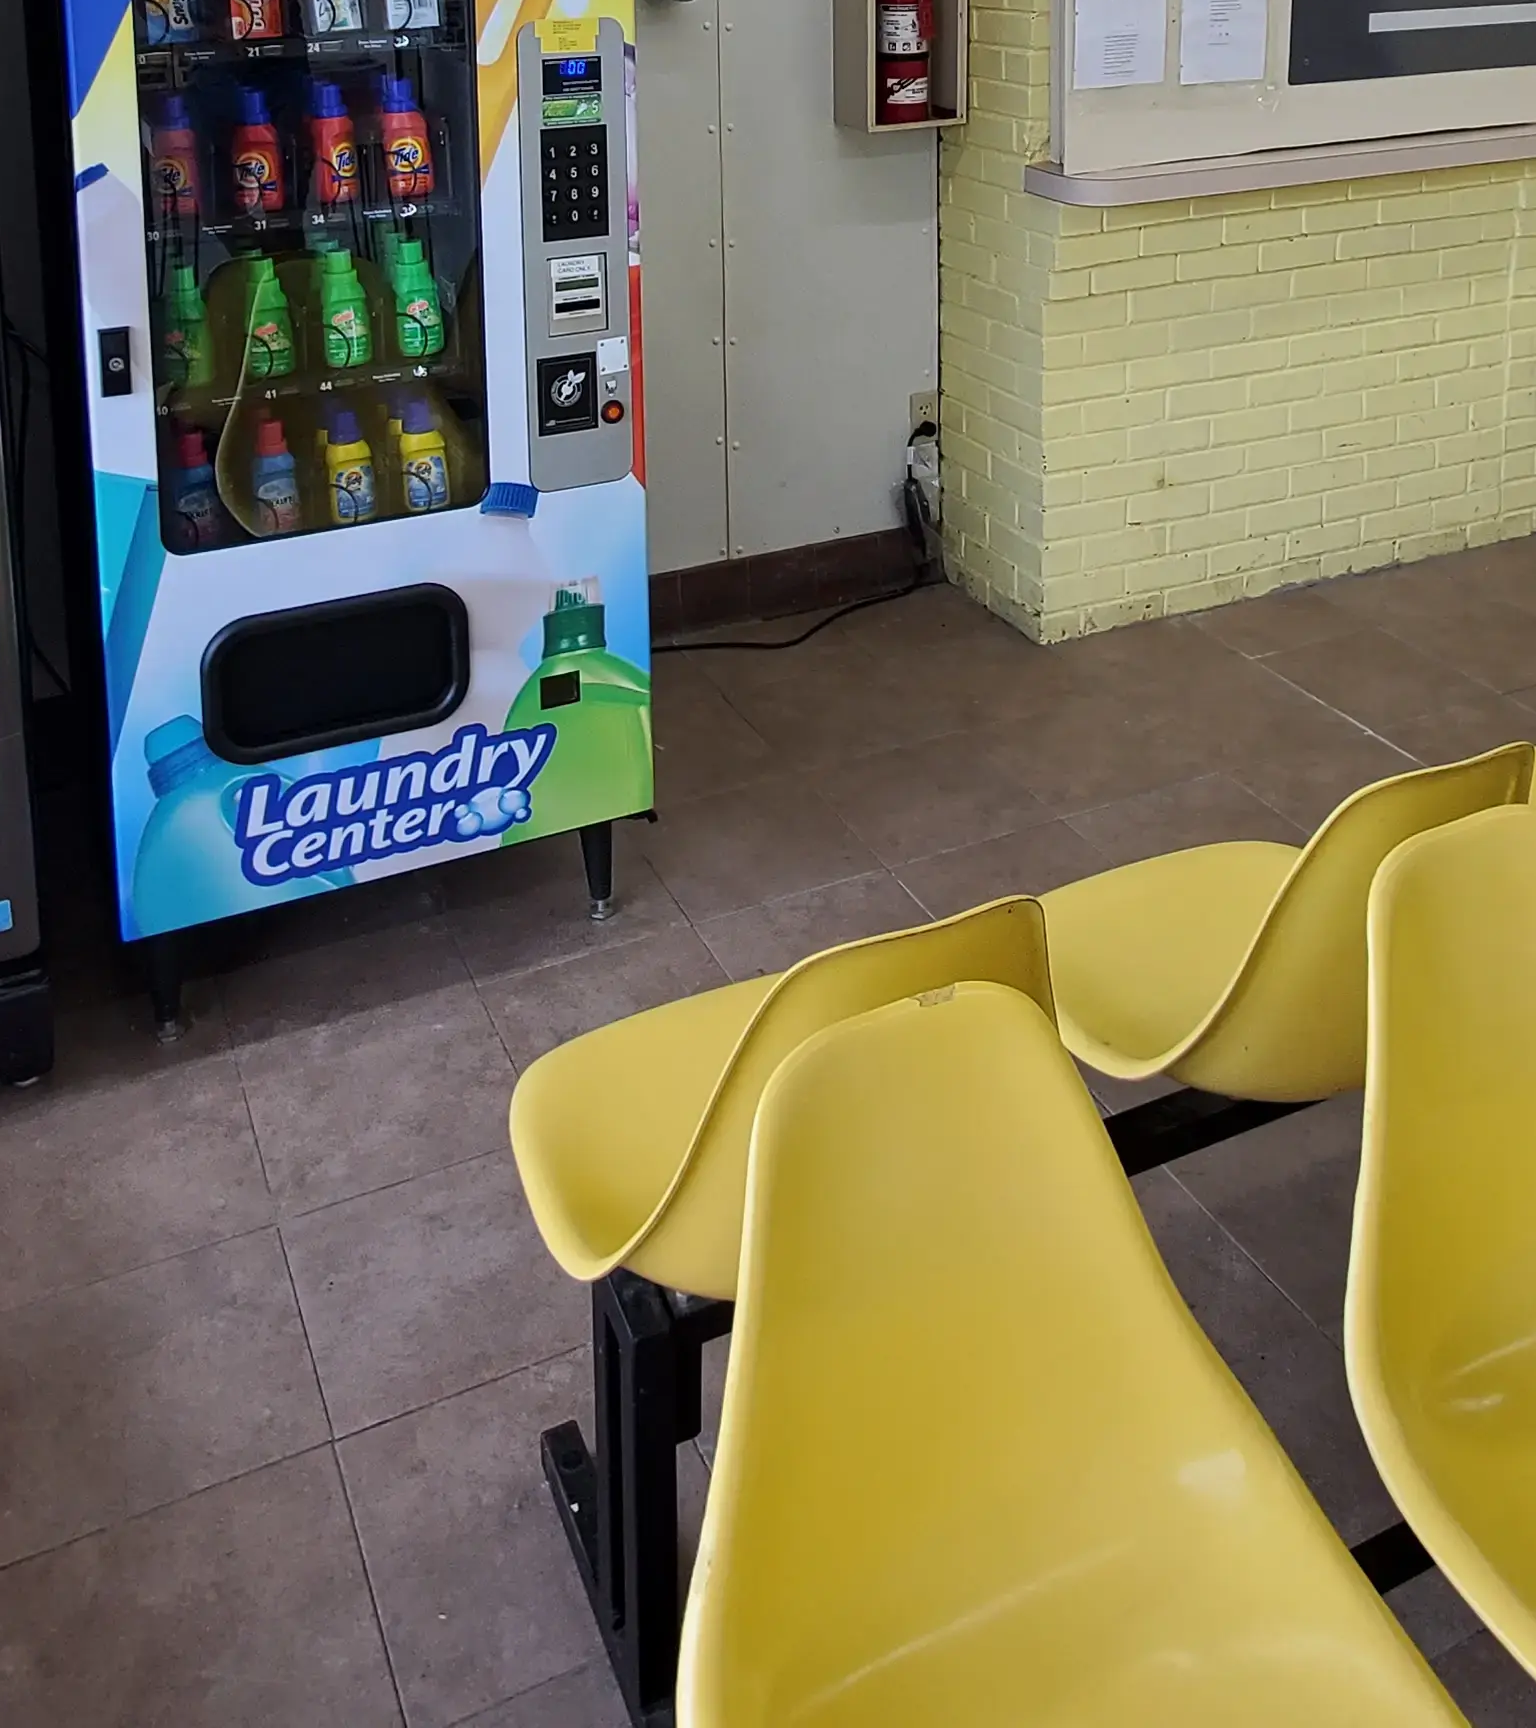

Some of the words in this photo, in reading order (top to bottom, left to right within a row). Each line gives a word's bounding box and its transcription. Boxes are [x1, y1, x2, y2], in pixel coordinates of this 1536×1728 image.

[247, 47, 260, 58] 21
[307, 42, 321, 53] 24
[549, 147, 556, 159] 1
[570, 145, 577, 157] 2
[590, 143, 598, 155] 3
[392, 148, 420, 168] Tide
[549, 168, 557, 180] 4
[570, 167, 578, 178] 5
[591, 164, 599, 176] 6
[550, 190, 558, 202] 7
[571, 188, 578, 200] 8
[591, 185, 600, 198] 9
[311, 214, 325, 225] 34
[571, 210, 579, 222] 0
[253, 220, 267, 231] 31
[146, 231, 160, 242] 30
[319, 381, 333, 391] 44
[264, 389, 277, 400] 41
[245, 728, 548, 840] Laundry
[251, 793, 459, 877] Center
